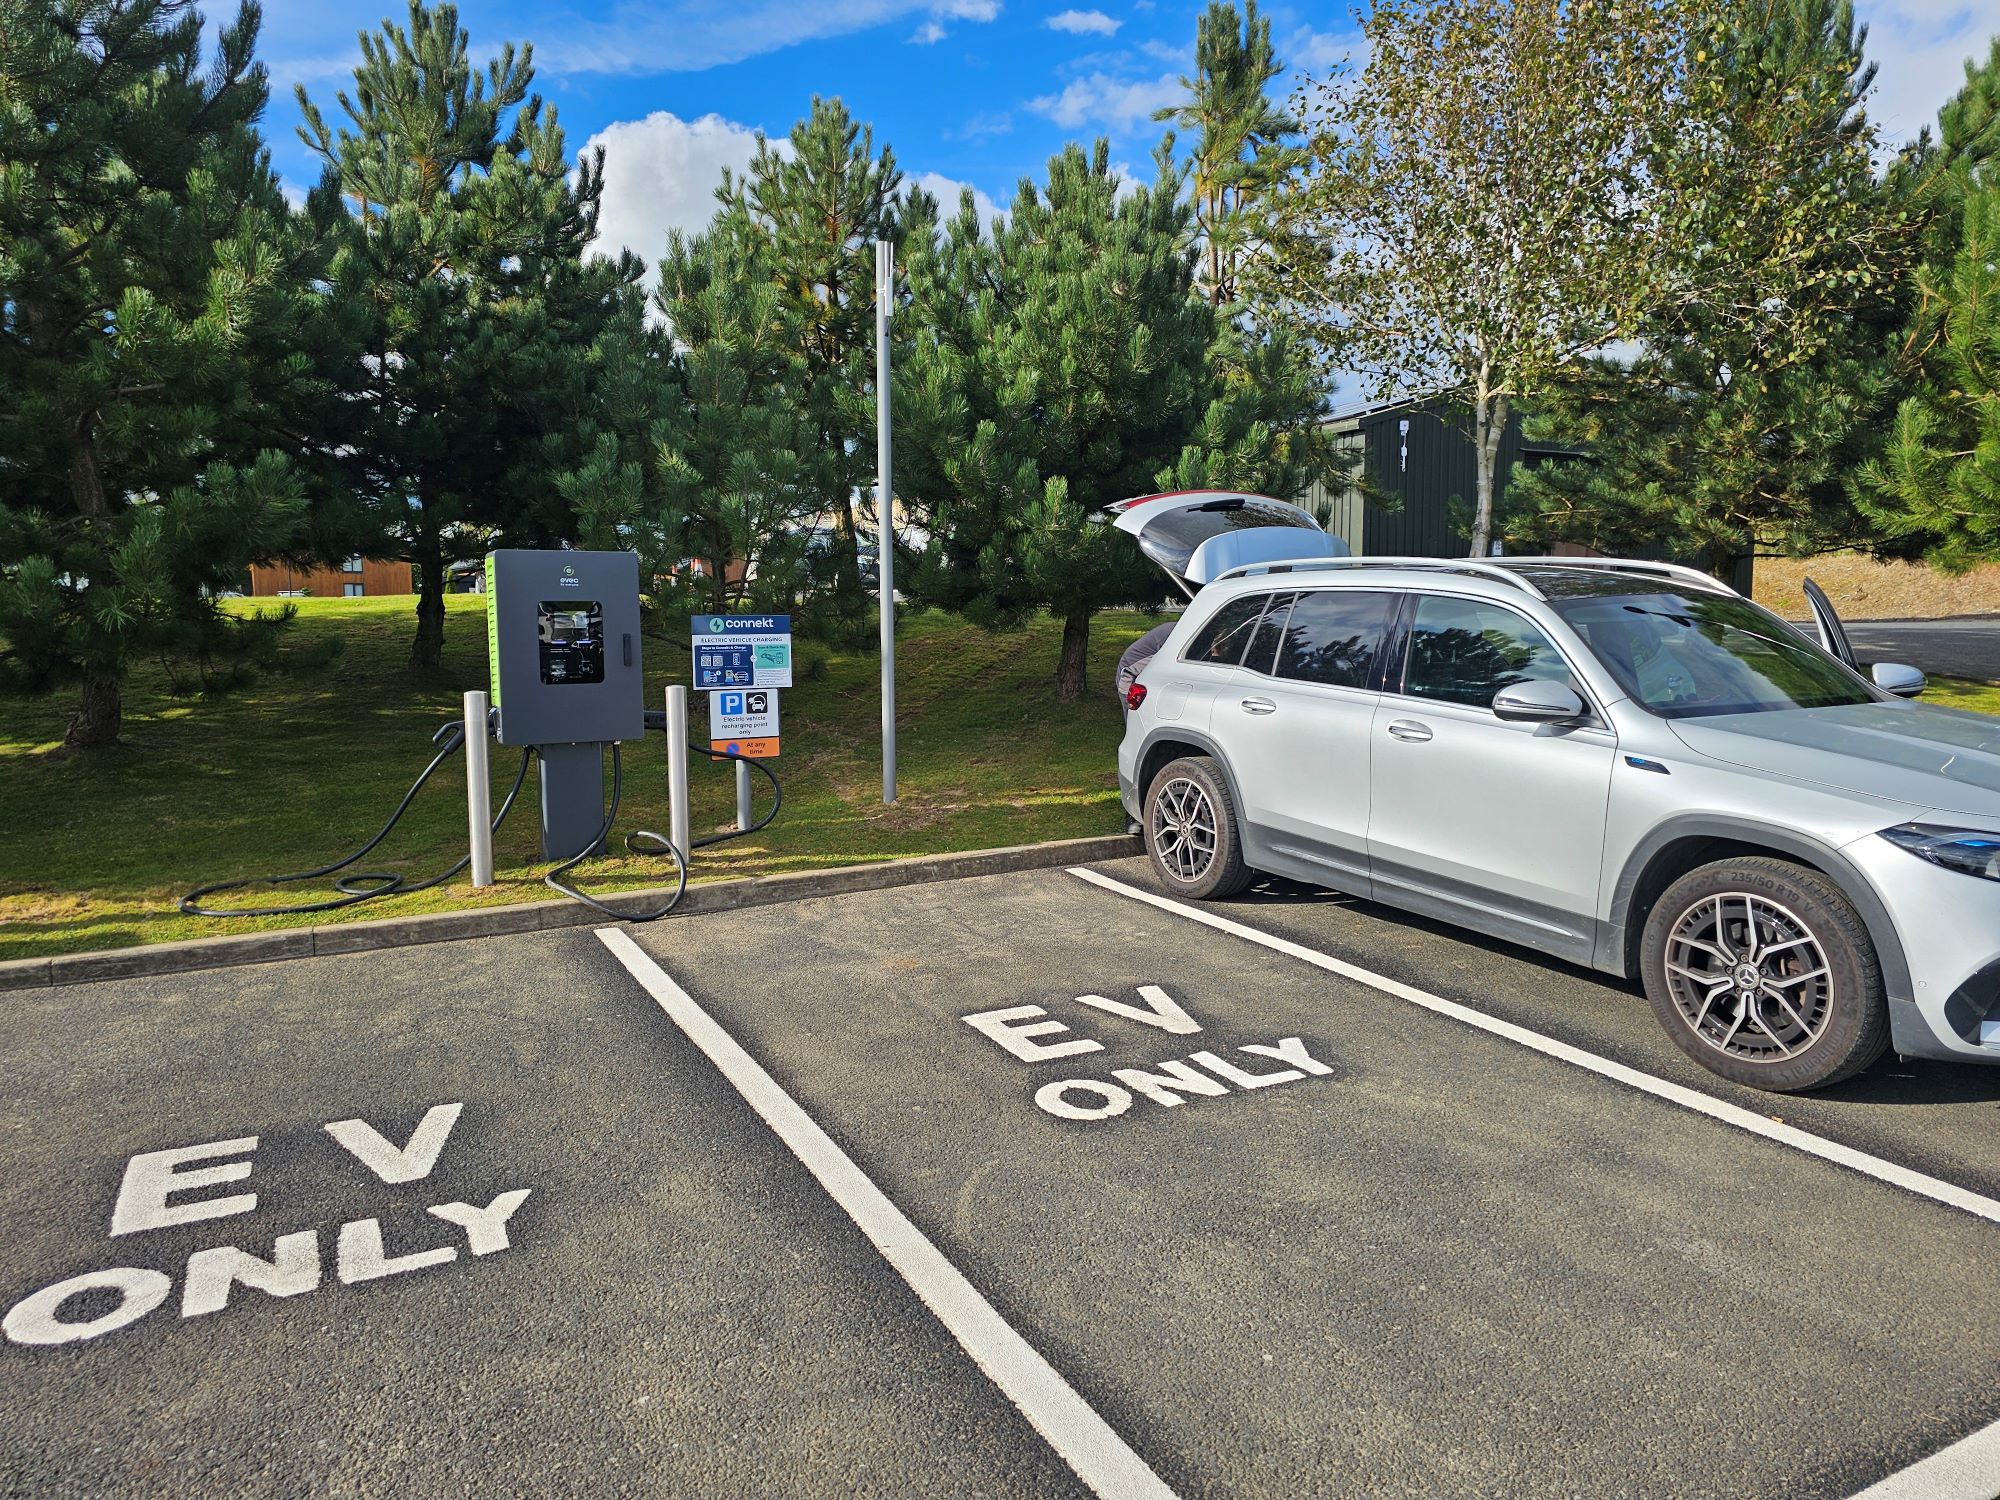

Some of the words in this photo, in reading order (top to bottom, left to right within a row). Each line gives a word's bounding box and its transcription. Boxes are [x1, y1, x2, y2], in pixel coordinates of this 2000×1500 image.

[725, 617, 774, 628] connekt
[726, 695, 739, 713] P
[1730, 871, 1775, 890] 235/50
[1034, 1037, 1334, 1121] ONLY
[2, 1189, 532, 1345] ONLY
